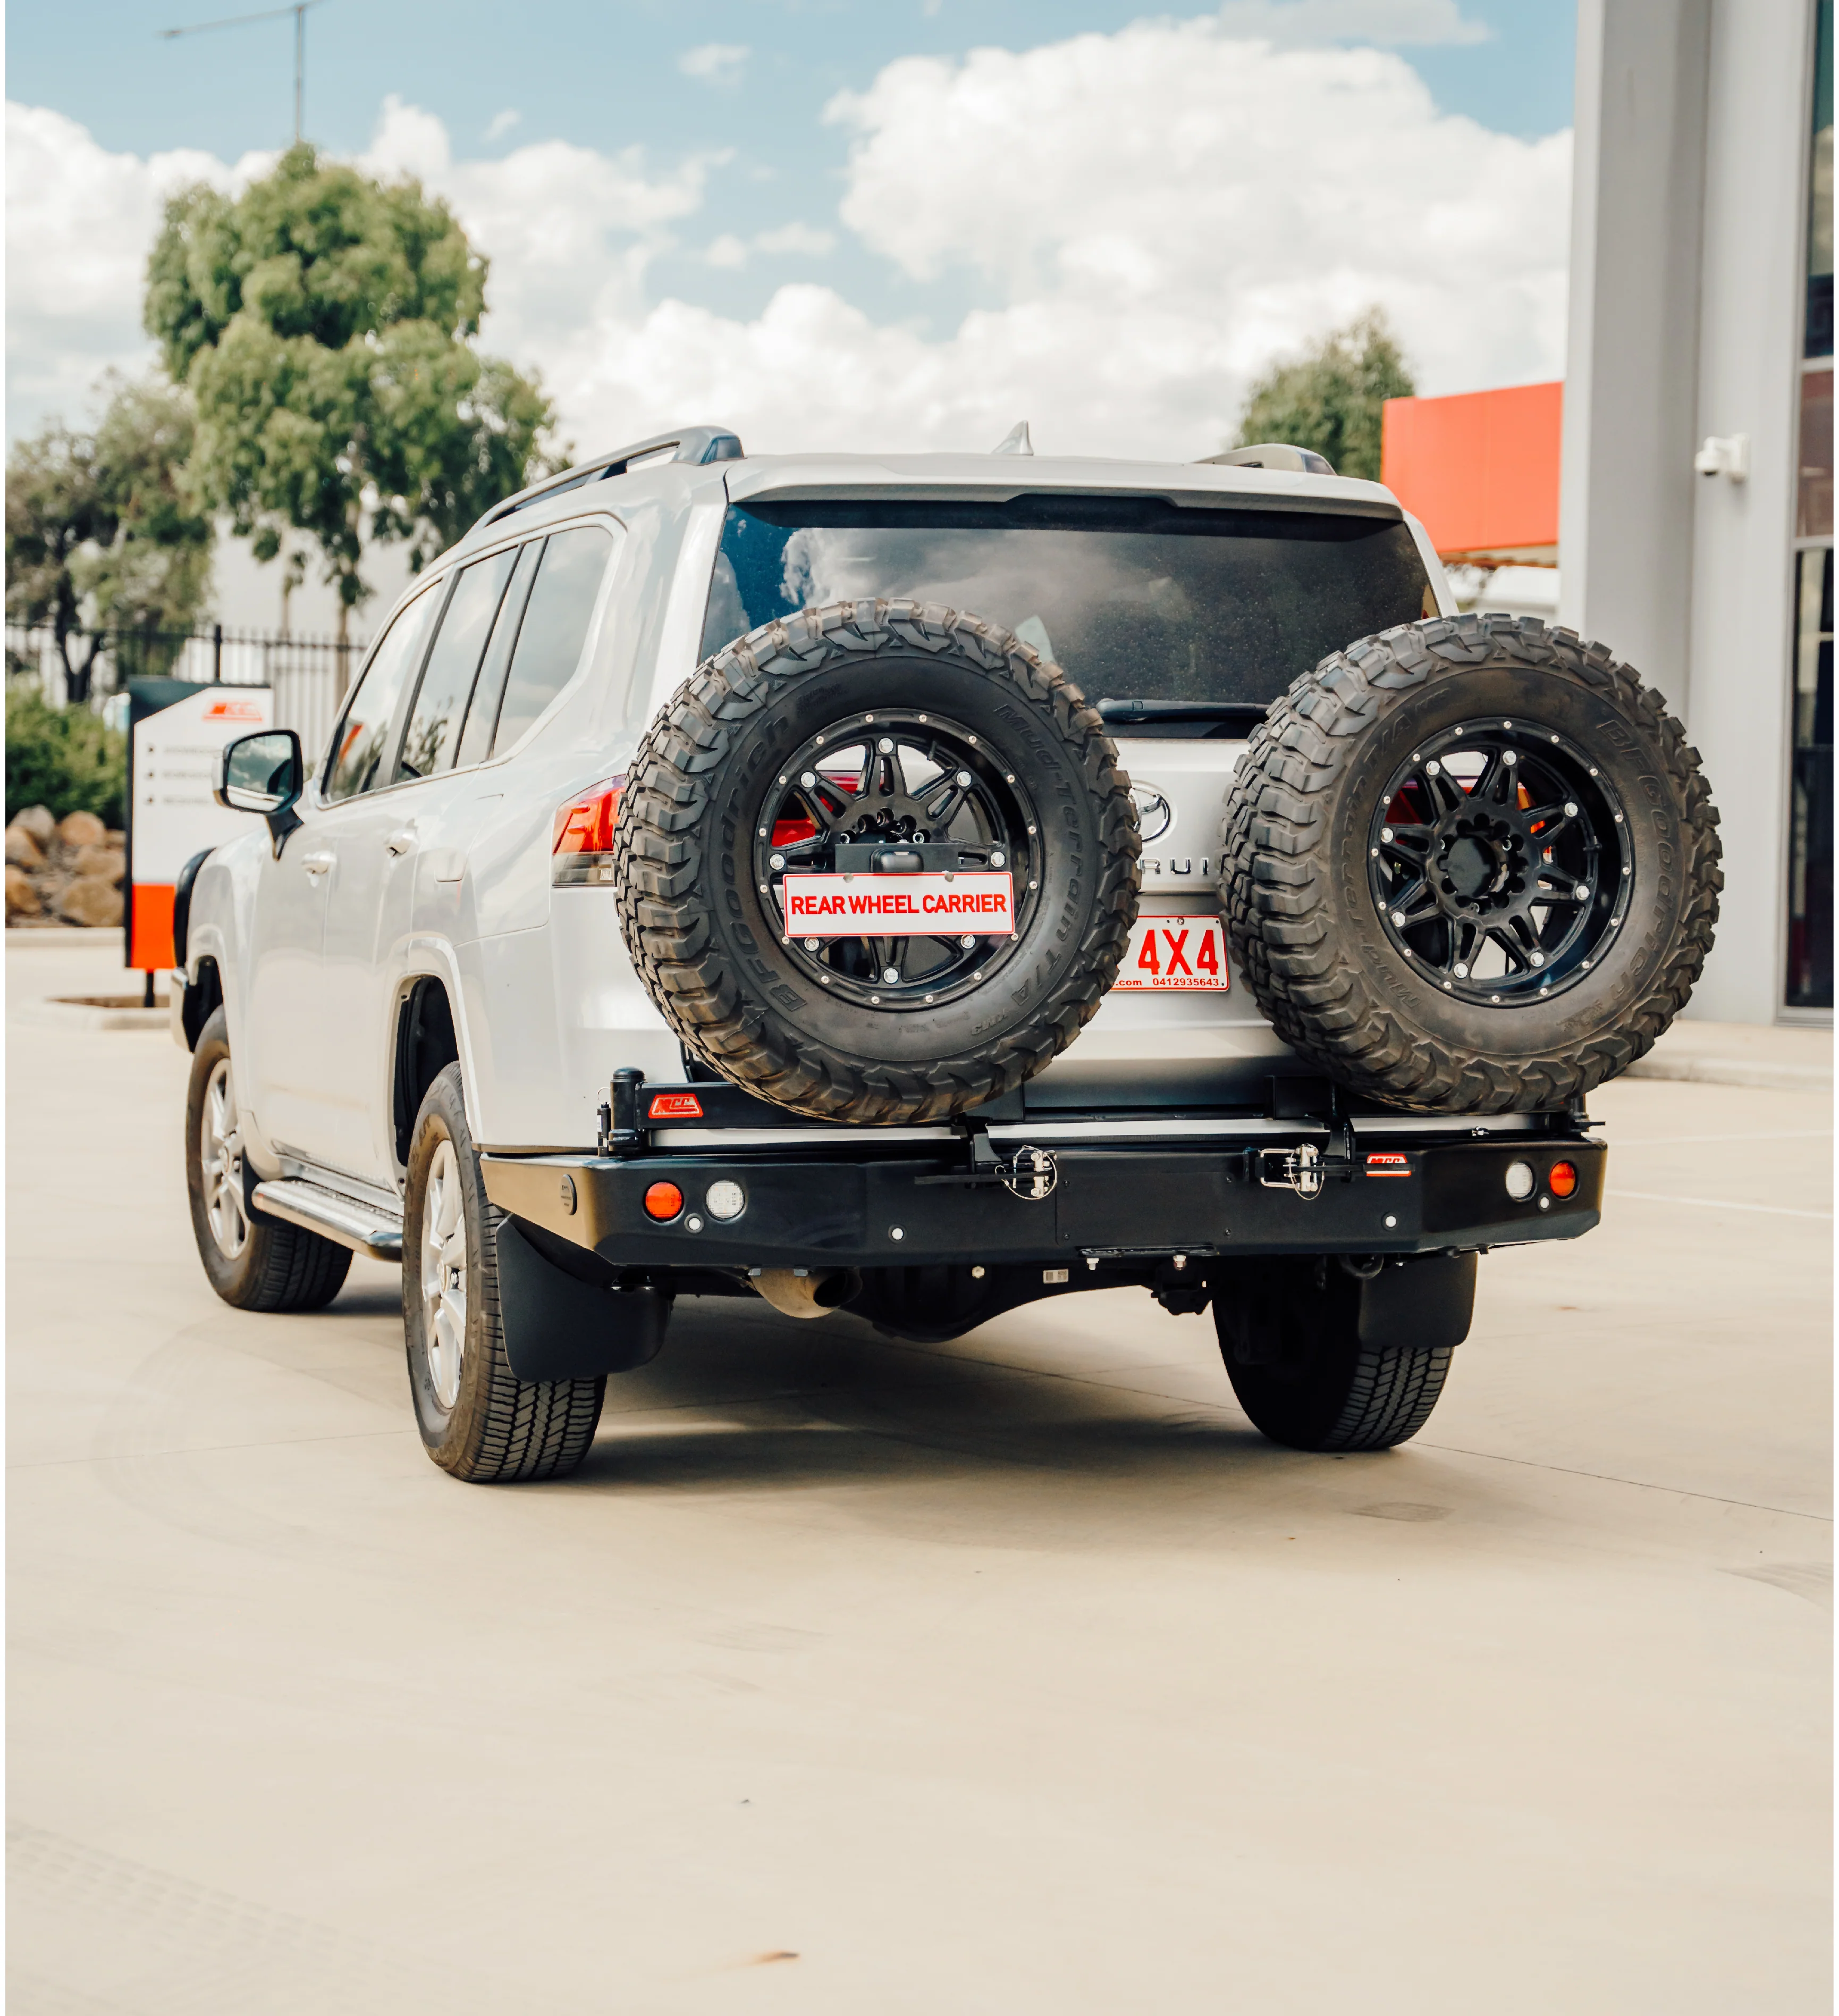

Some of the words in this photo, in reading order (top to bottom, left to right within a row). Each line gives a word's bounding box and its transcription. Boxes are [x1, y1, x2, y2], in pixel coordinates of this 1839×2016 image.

[721, 716, 807, 1012] BFGoodrich
[993, 703, 1083, 941] Mud-Terrain
[1596, 719, 1674, 1000] BFGoodrich
[791, 896, 845, 914] REAR
[849, 895, 920, 914] WHEEL
[923, 894, 1007, 913] CARRIER
[1138, 929, 1219, 976] 4X4
[1152, 978, 1219, 986] 0412935643
